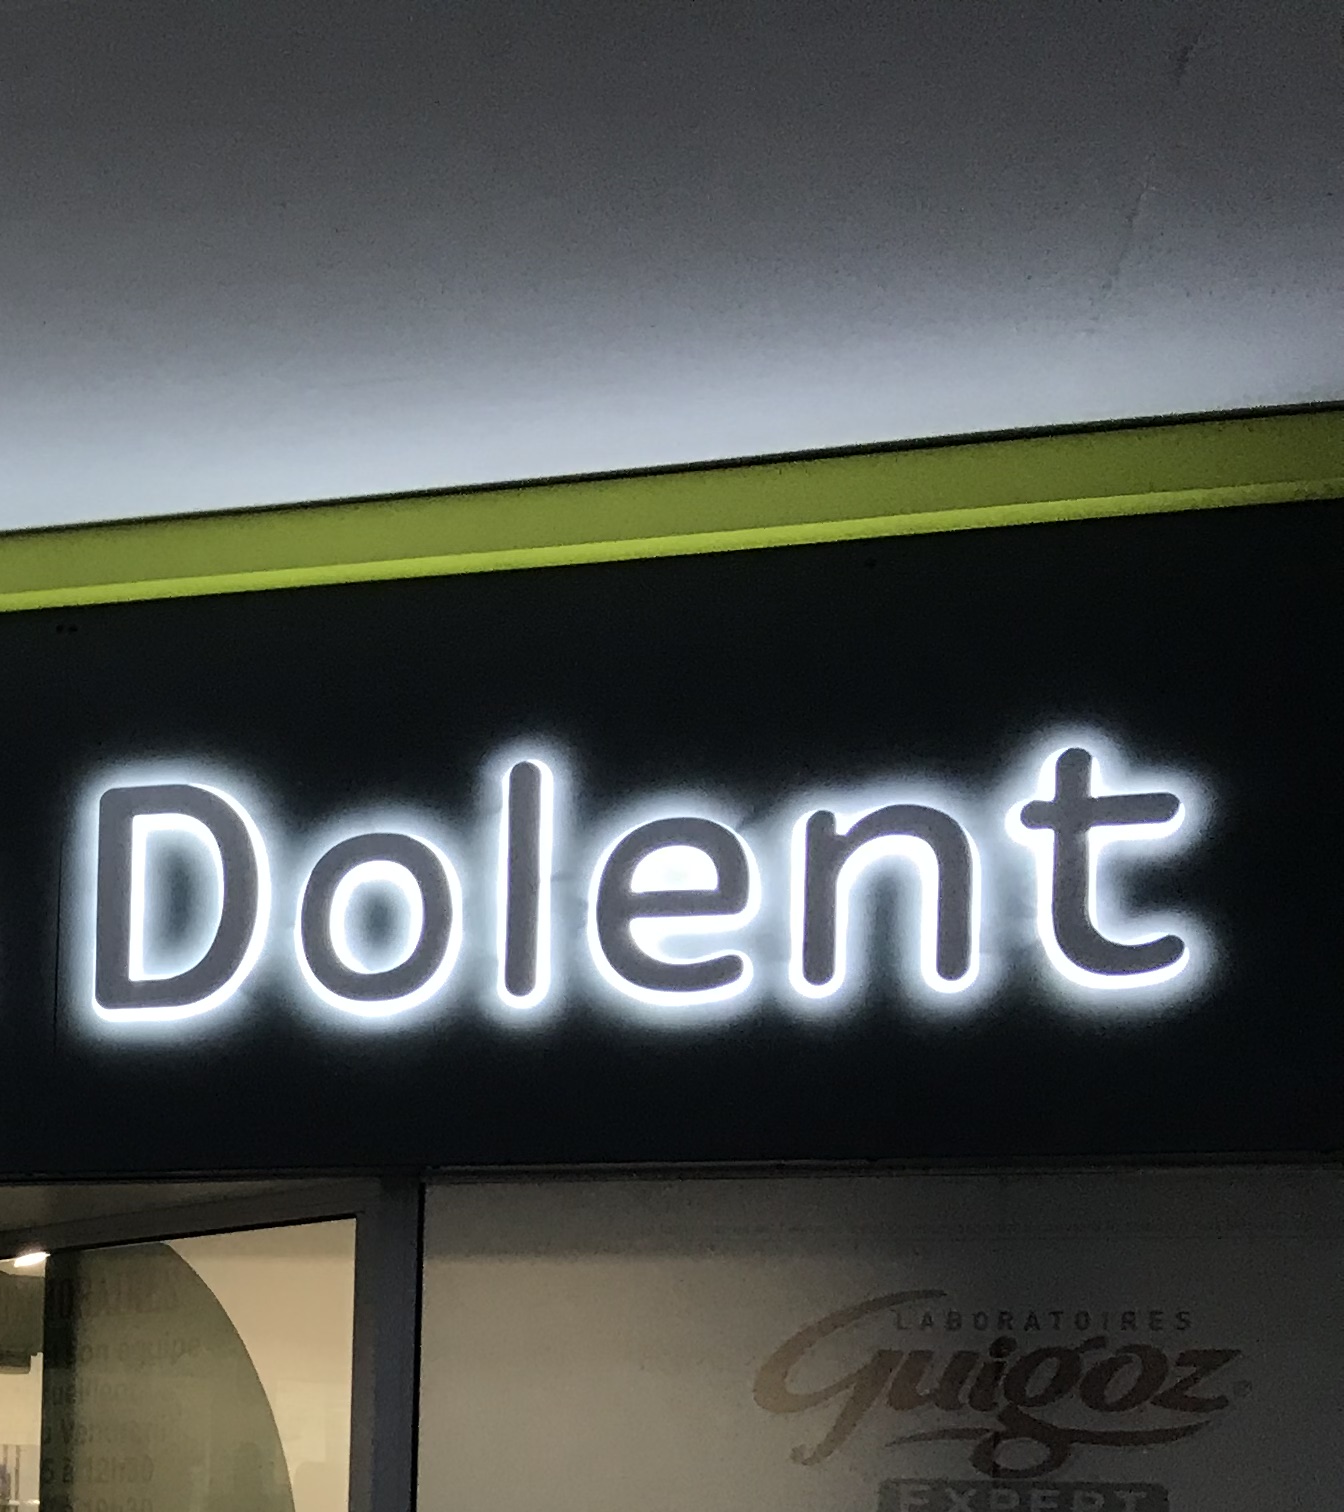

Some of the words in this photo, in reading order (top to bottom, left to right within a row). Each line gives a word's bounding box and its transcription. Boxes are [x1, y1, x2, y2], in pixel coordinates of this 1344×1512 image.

[92, 745, 1190, 1012] Dolent
[753, 1290, 1244, 1480] Guigoz
[896, 1309, 1196, 1334] LABORATOIRES
